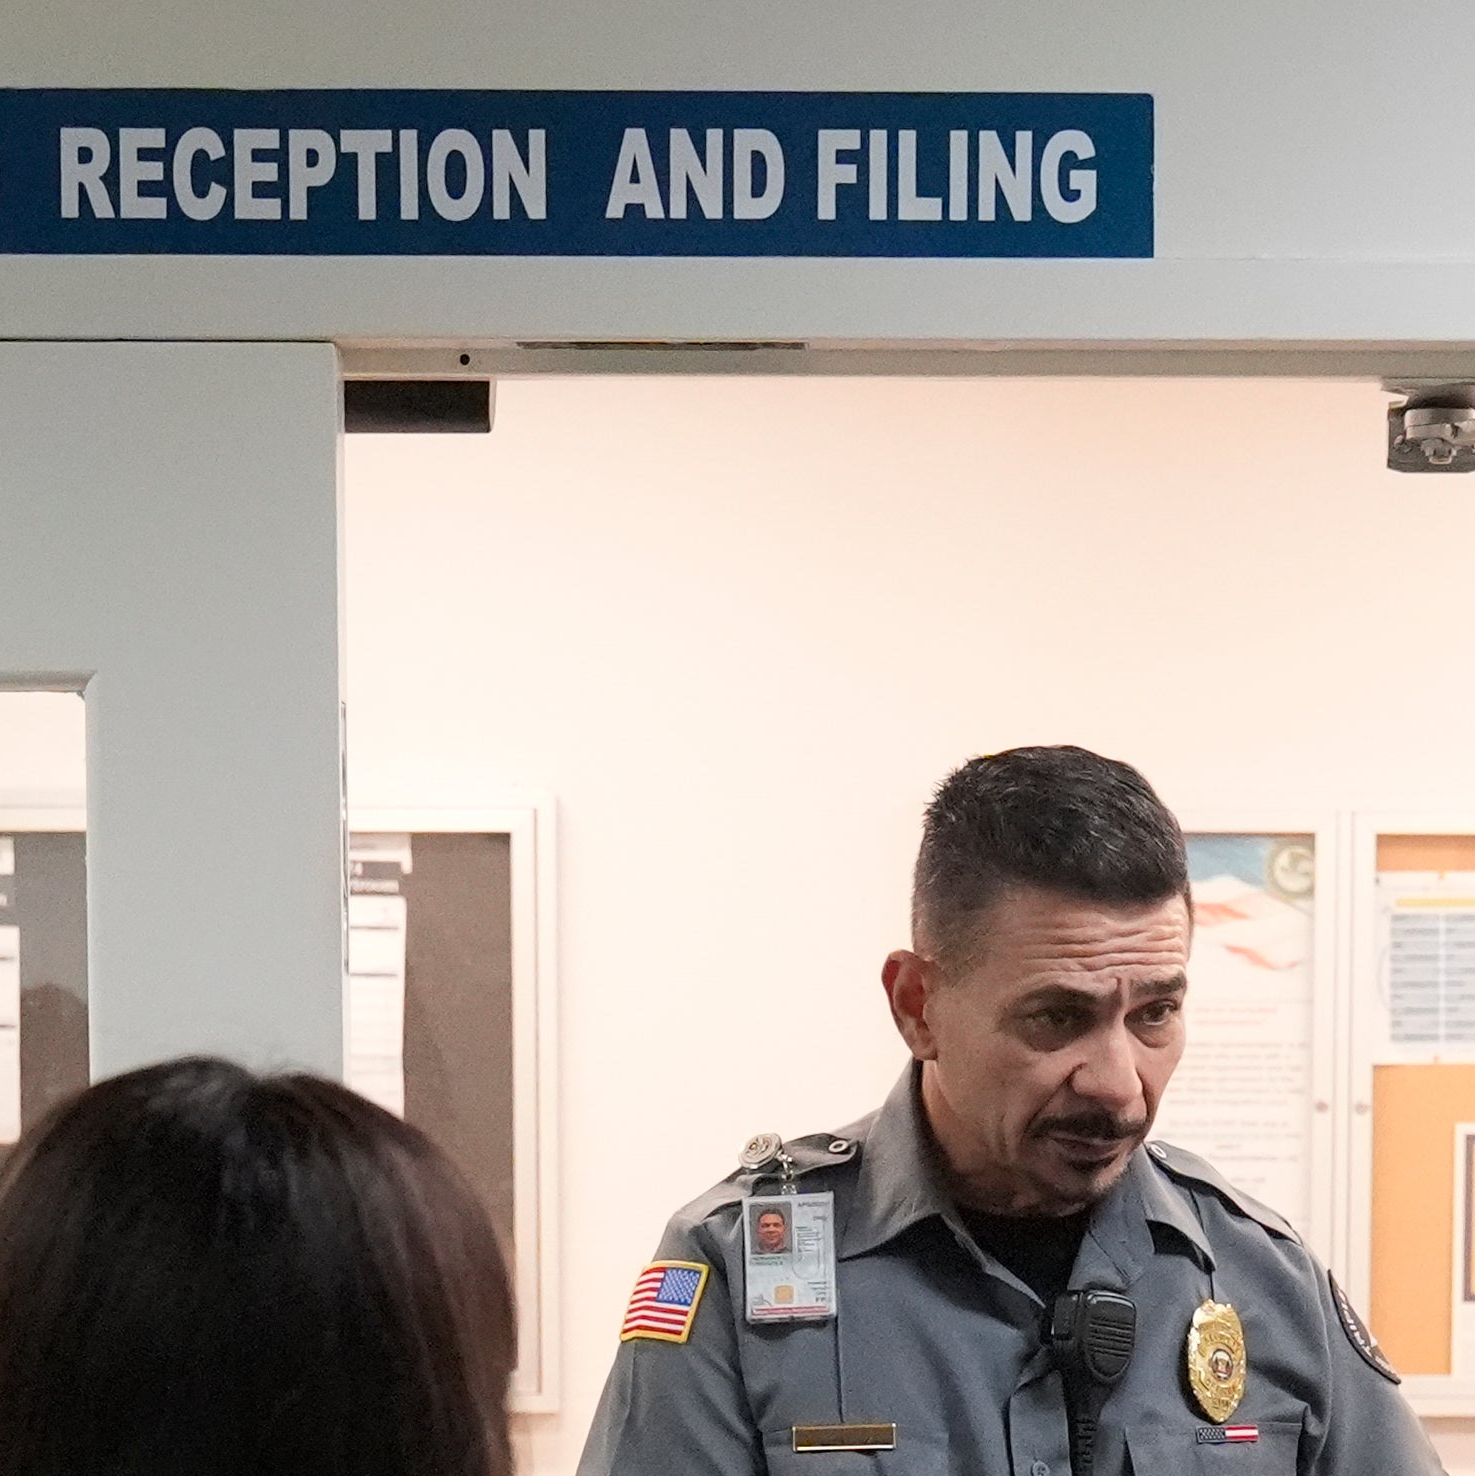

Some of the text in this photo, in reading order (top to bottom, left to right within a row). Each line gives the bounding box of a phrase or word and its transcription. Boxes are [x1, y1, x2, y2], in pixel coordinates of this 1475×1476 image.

[61, 128, 546, 221] RECEPTION
[606, 128, 784, 219] AND
[818, 130, 1096, 223] FILING
